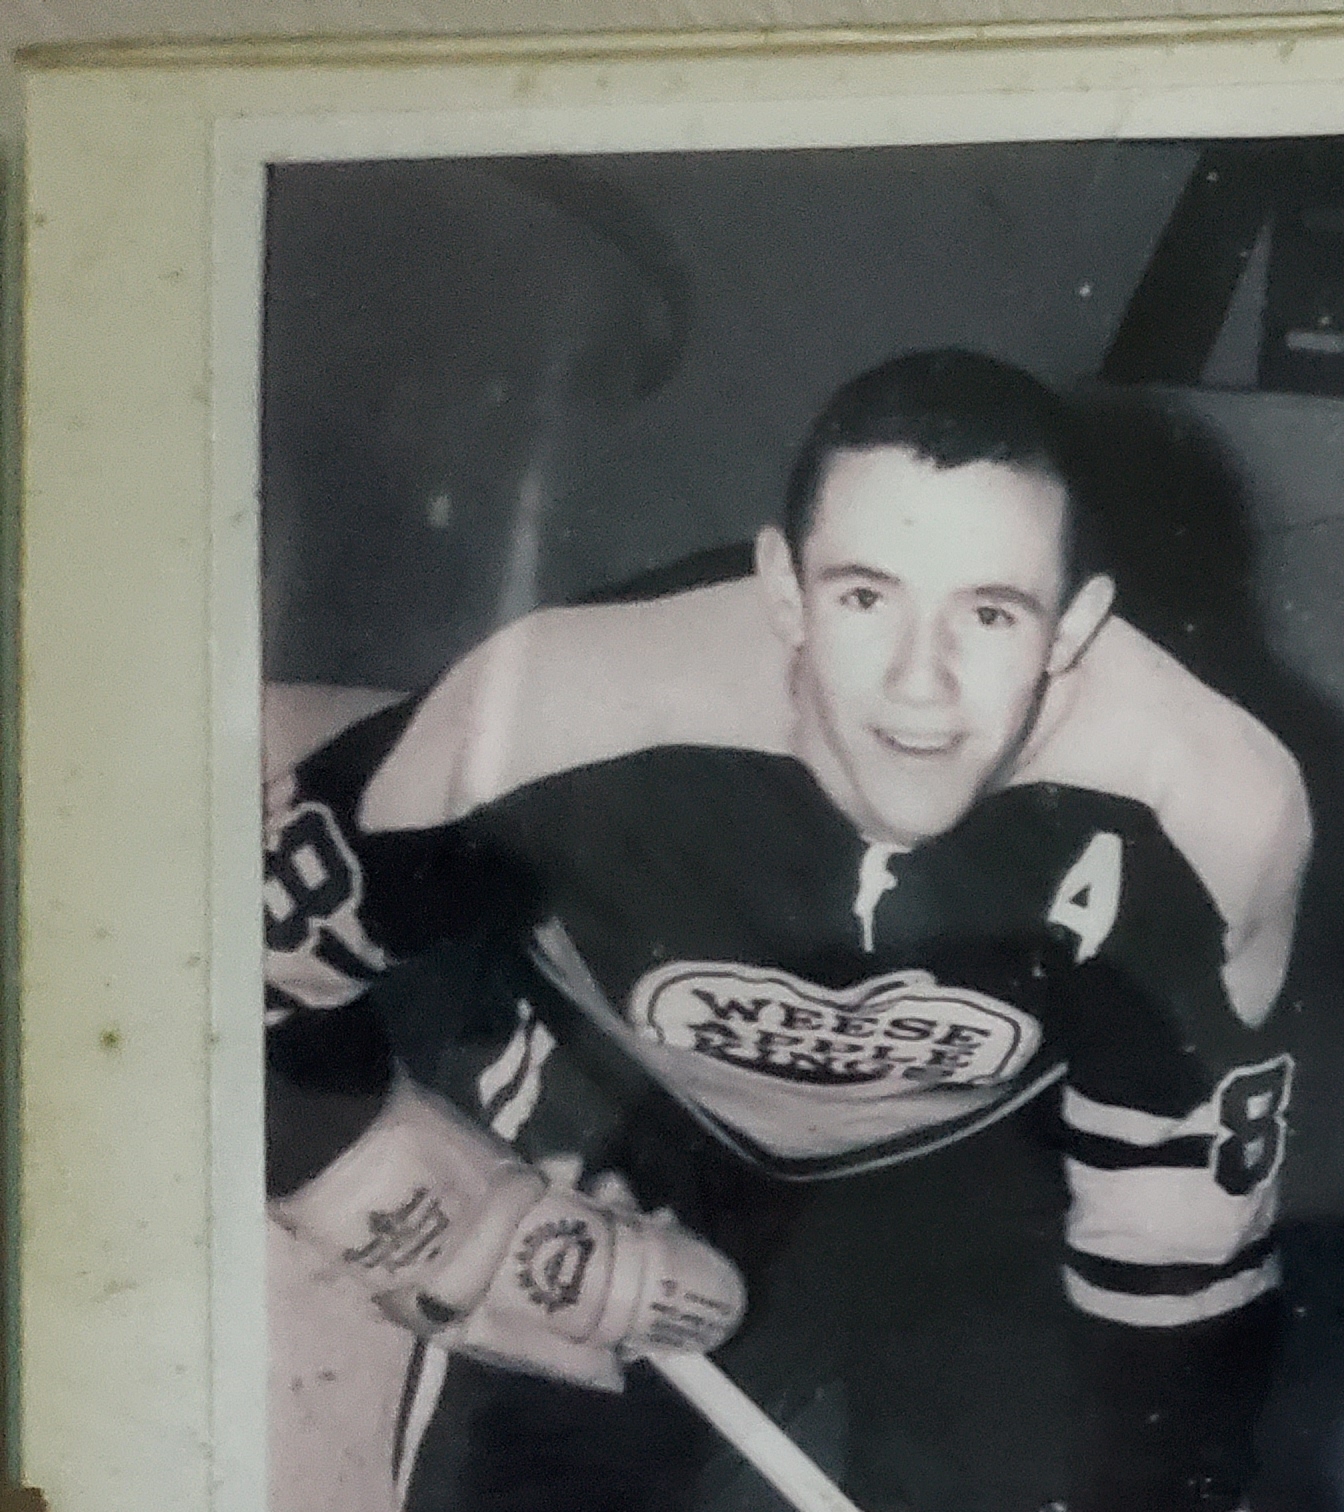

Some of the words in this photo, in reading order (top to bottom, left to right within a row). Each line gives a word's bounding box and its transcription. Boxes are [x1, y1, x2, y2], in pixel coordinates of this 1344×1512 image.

[1047, 832, 1123, 964] A
[691, 988, 991, 1047] WEESE
[1211, 1054, 1294, 1197] 8
